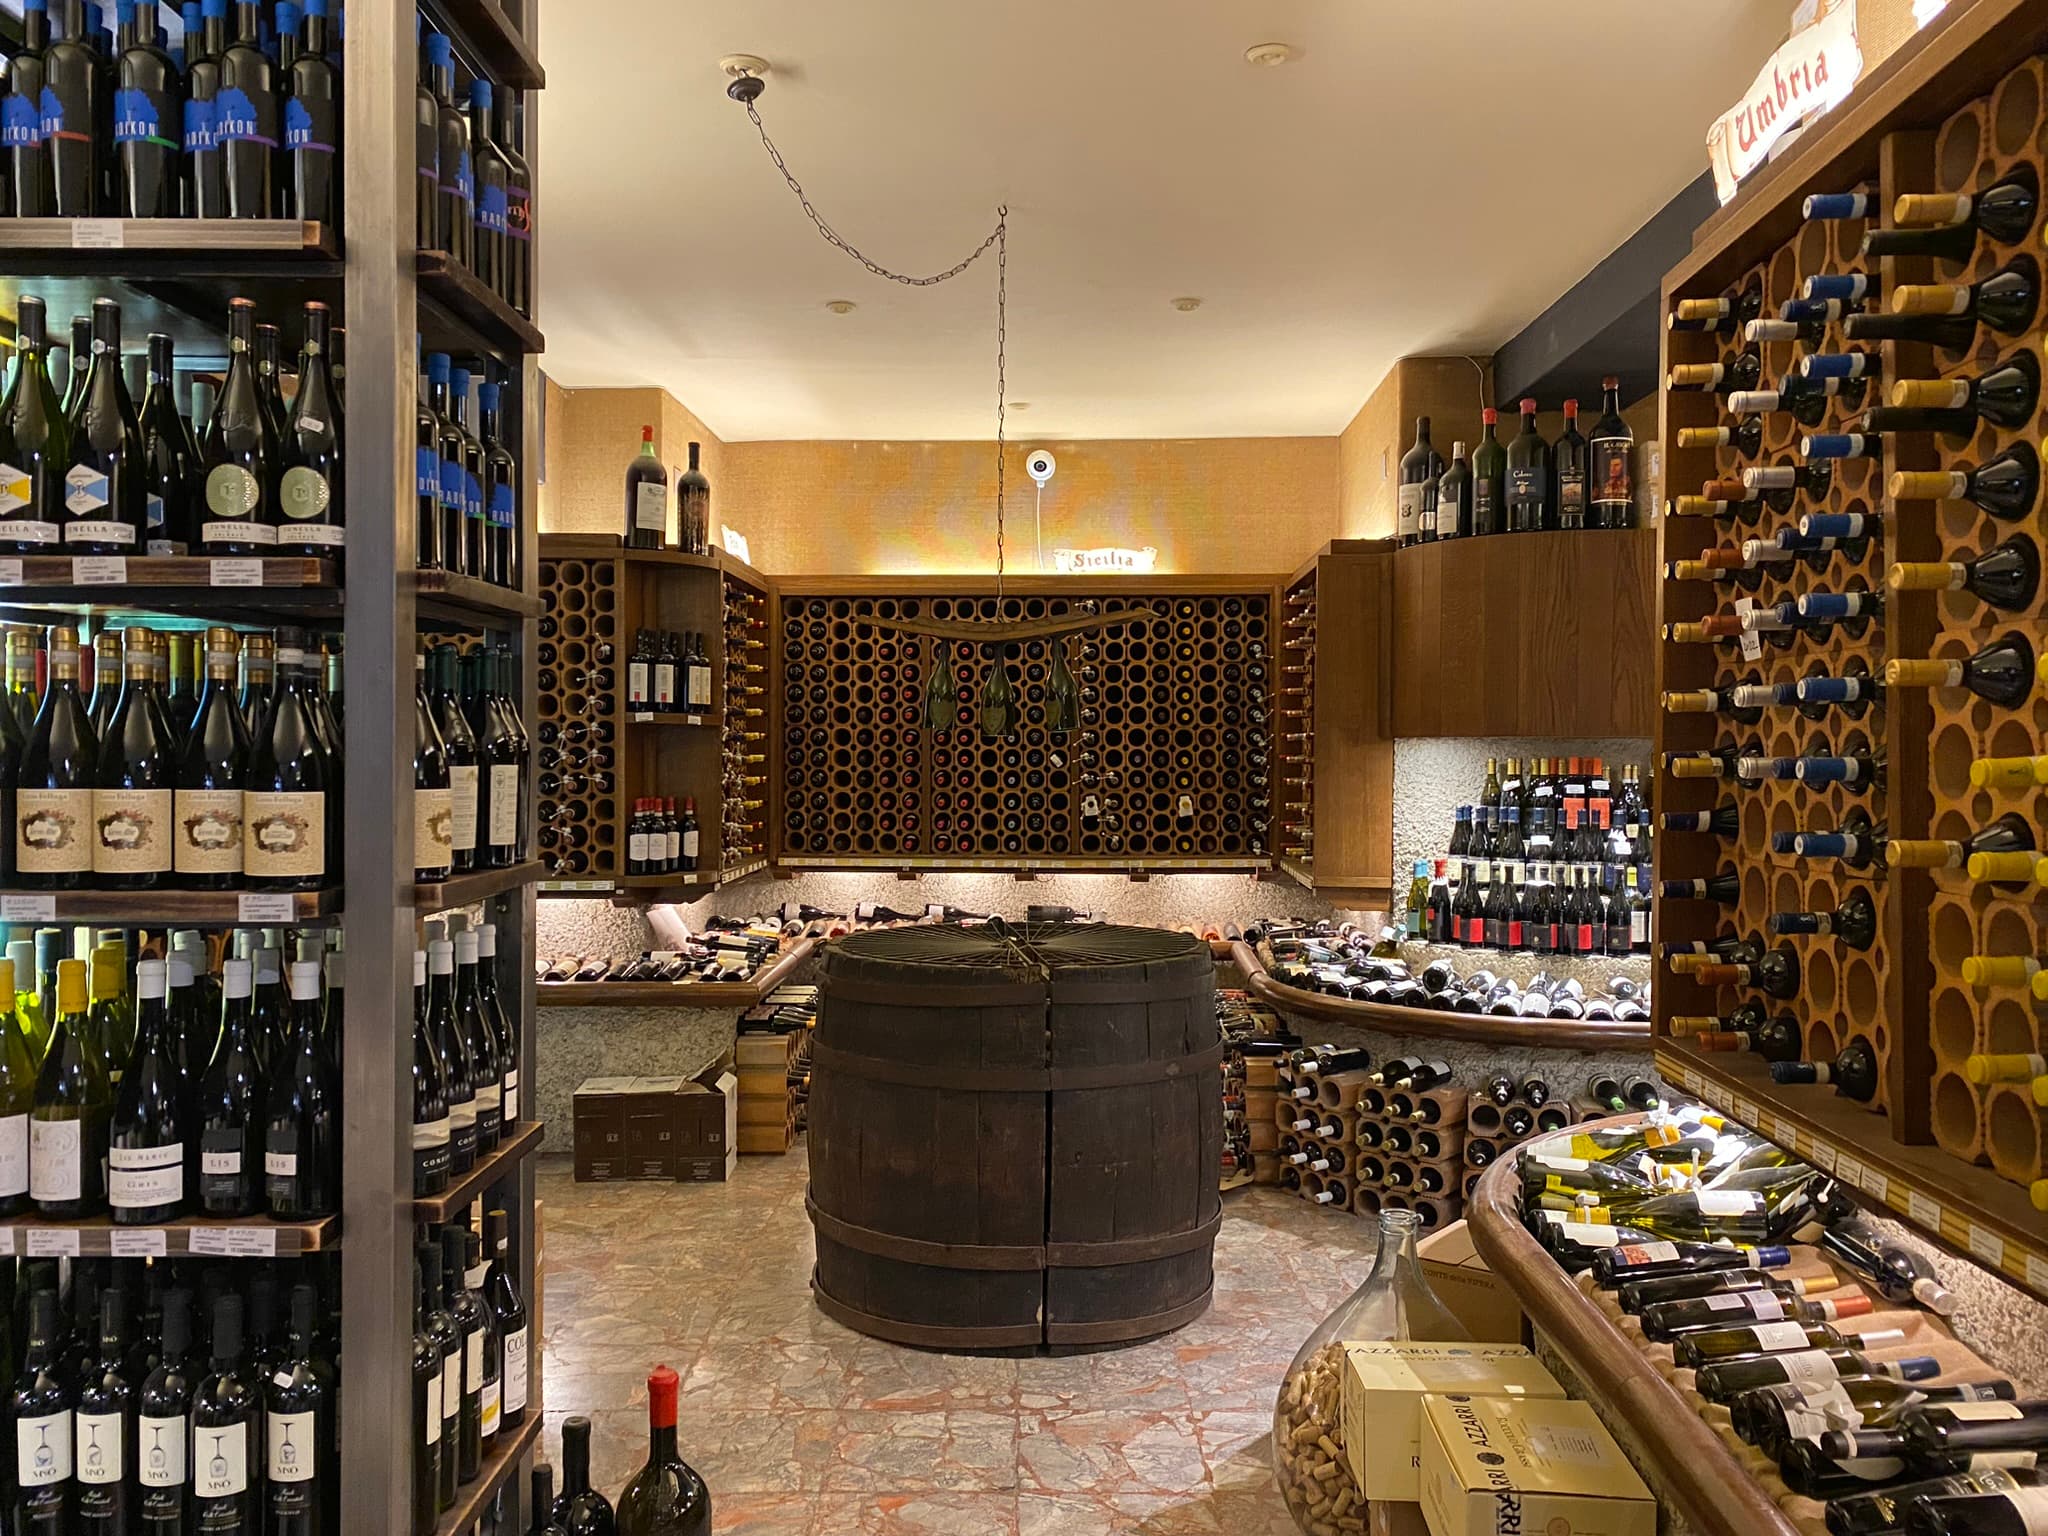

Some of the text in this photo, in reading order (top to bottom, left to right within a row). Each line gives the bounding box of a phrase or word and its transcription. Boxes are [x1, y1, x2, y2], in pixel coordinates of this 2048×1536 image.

[1735, 49, 1829, 152] Umbria
[1073, 551, 1134, 568] Sicilia
[1452, 1404, 1492, 1449] AZZARRI
